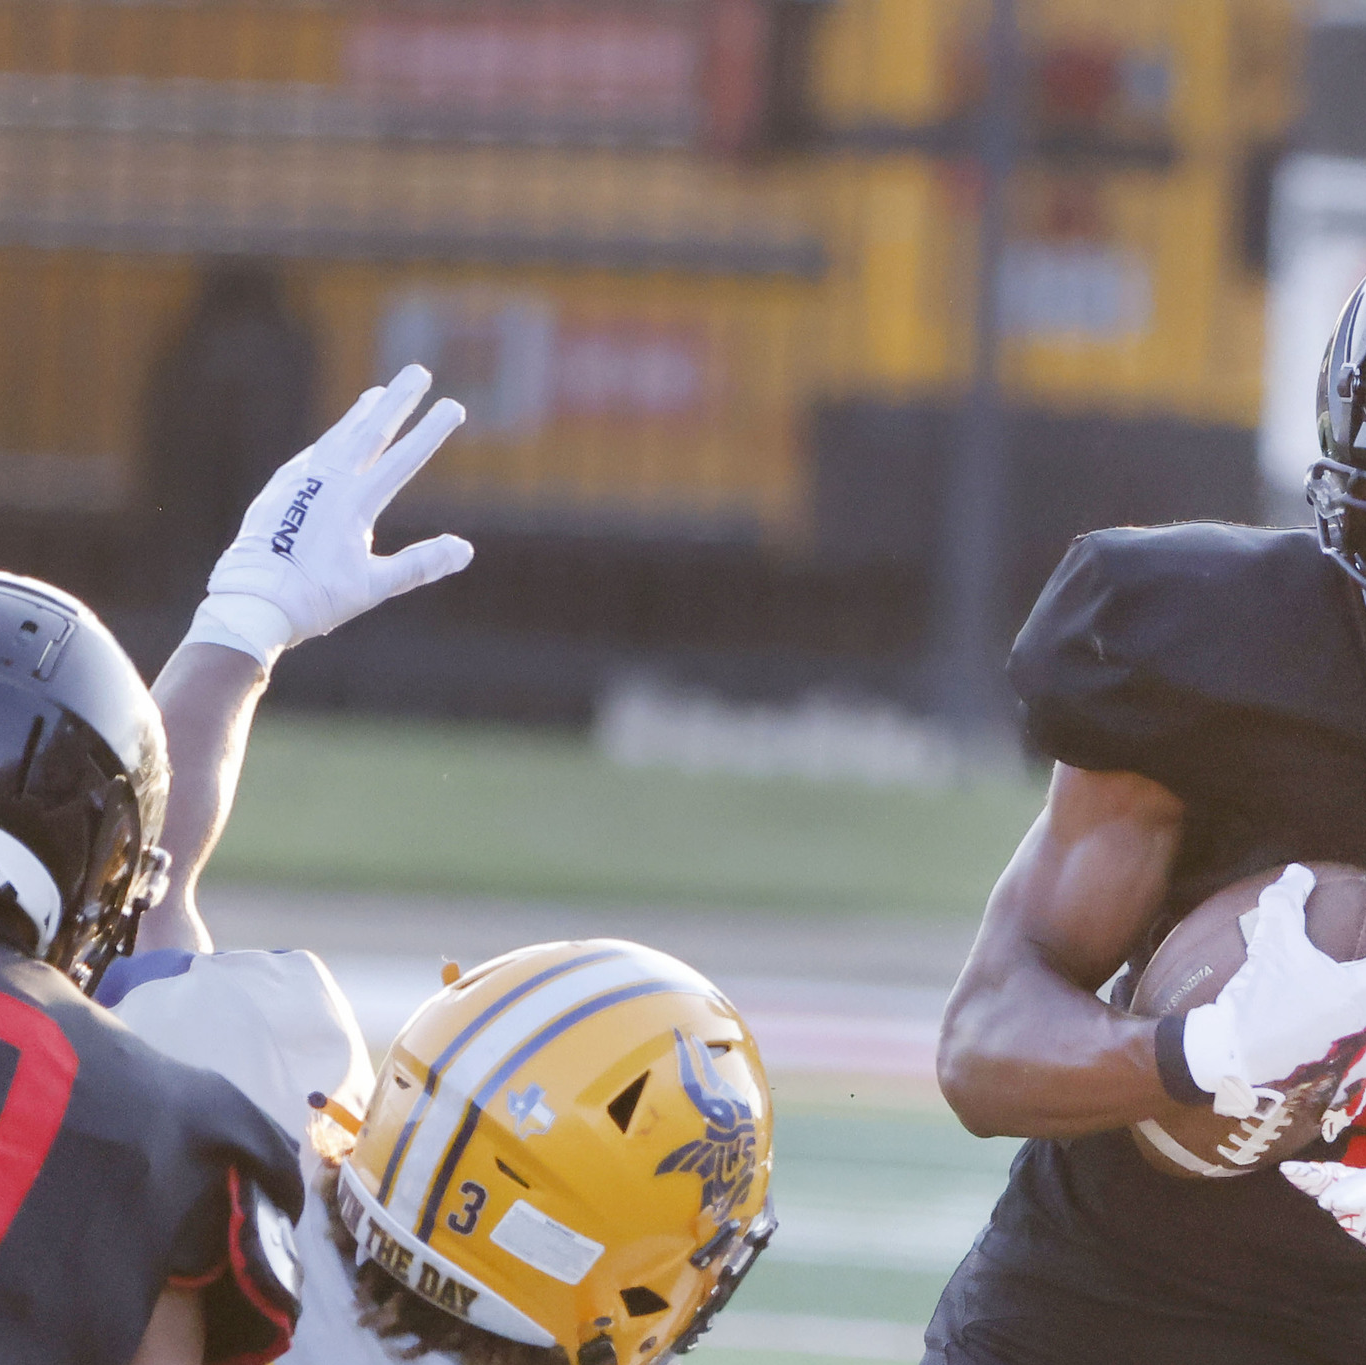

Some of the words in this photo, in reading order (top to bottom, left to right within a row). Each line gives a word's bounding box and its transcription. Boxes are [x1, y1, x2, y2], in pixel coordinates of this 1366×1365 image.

[447, 1180, 487, 1236] 3
[366, 1215, 415, 1284] THE
[417, 1261, 480, 1317] DAY
